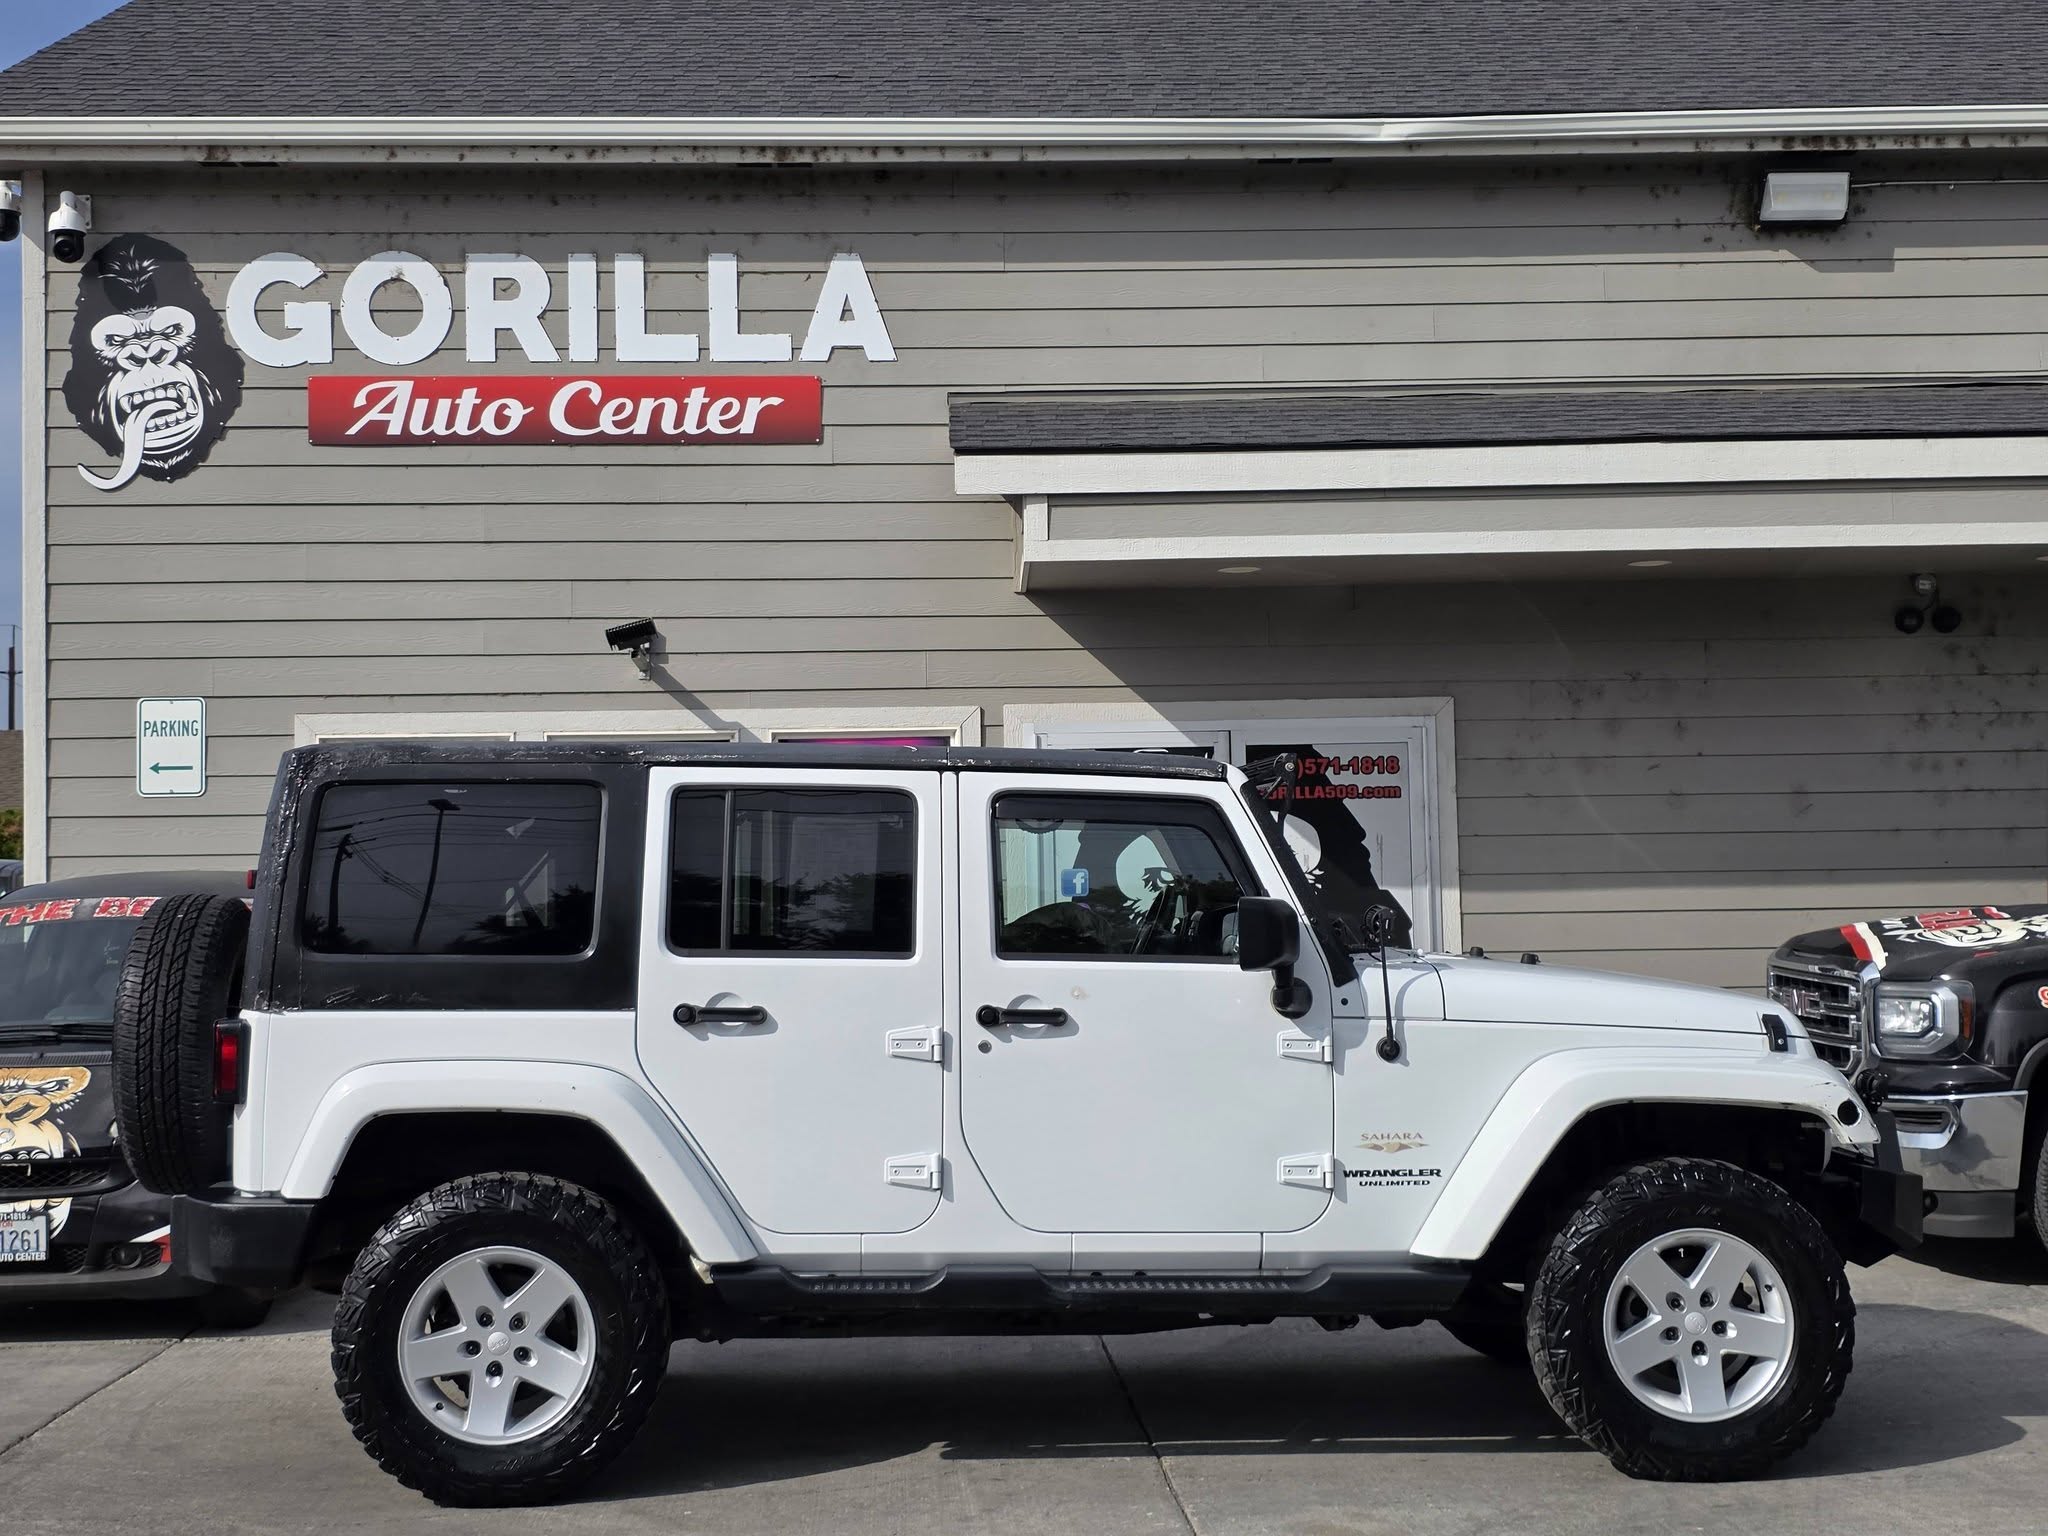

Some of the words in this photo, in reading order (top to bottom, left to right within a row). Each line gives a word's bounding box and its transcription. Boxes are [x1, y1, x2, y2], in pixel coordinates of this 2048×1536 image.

[226, 251, 898, 367] GORILLA
[344, 380, 535, 437] Auto
[549, 380, 784, 437] Center
[143, 719, 199, 737] PARKING
[1297, 756, 1400, 779] )571-1818
[1361, 1132, 1424, 1140] SAHARA
[1343, 1168, 1442, 1178] WRANGLER
[0, 1212, 26, 1220] 71-1818
[0, 1229, 40, 1251] 1261
[15, 1252, 46, 1261] CENTER
